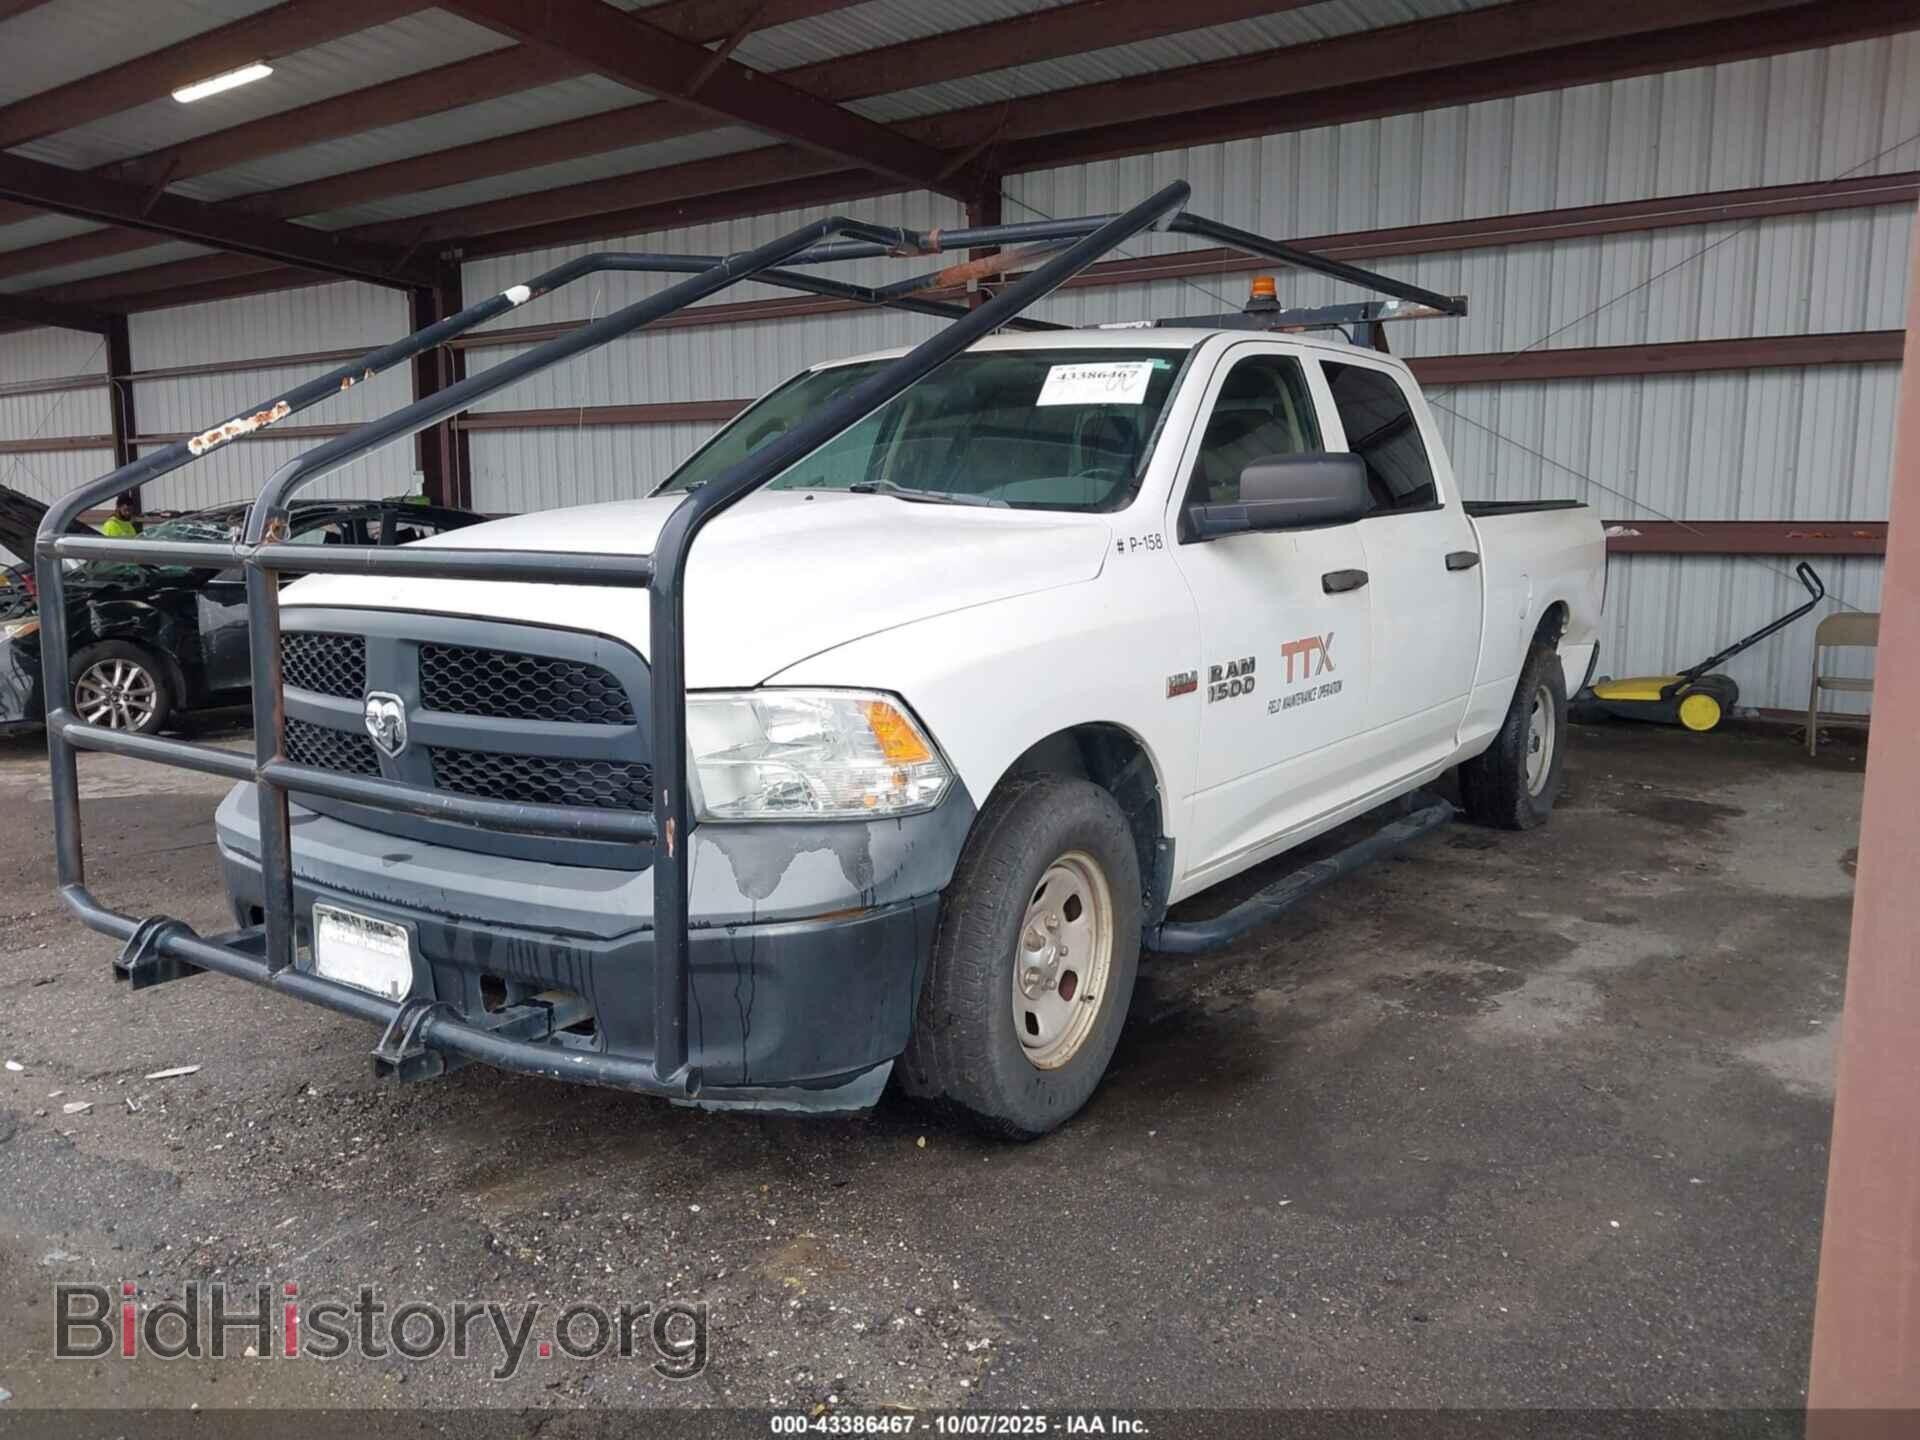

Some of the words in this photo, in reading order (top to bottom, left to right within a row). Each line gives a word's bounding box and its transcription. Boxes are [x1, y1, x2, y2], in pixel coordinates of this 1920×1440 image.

[1117, 538, 1125, 555] #
[1129, 533, 1163, 553] P-158
[1210, 656, 1256, 683] RAM
[1281, 632, 1336, 684] TTX
[1208, 676, 1255, 703] 1500
[1282, 687, 1317, 710] MAINTENANCE
